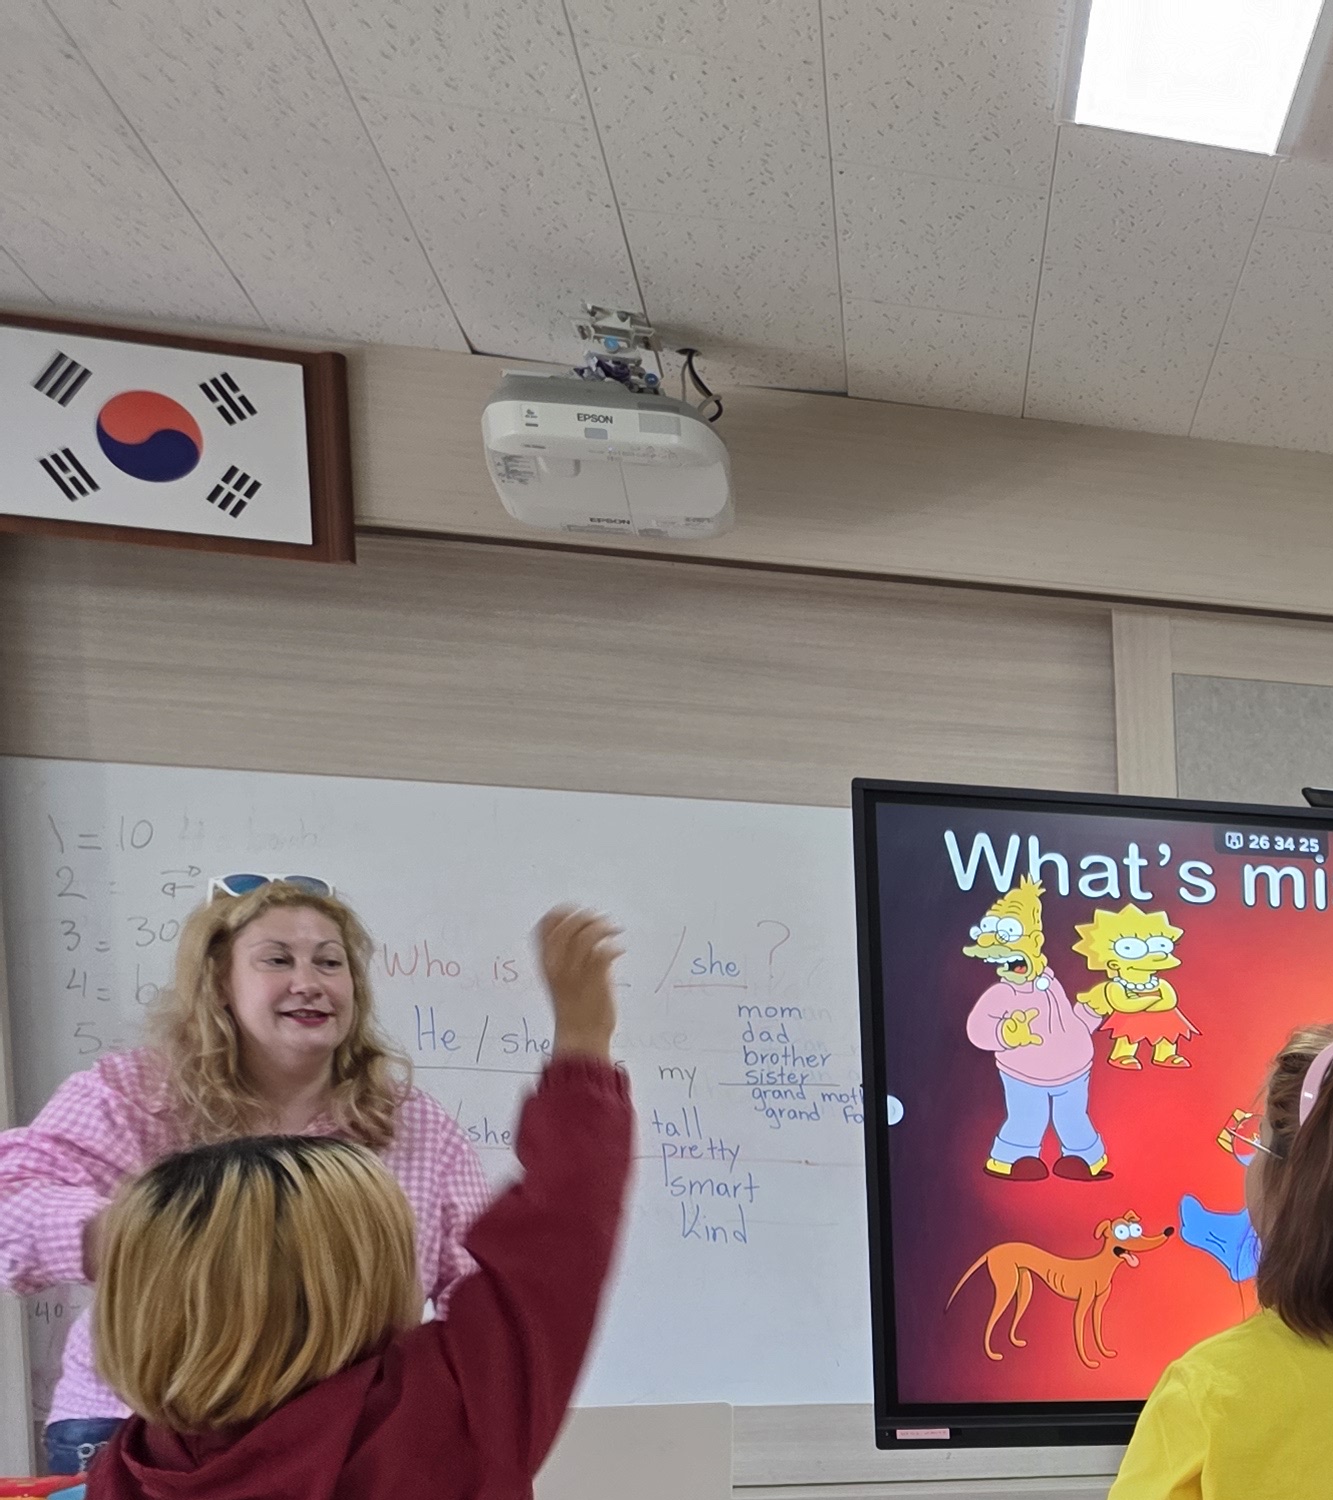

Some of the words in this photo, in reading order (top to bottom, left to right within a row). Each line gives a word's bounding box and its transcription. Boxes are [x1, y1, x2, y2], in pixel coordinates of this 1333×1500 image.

[577, 413, 613, 424] EPSON
[1249, 834, 1271, 849] 26
[1274, 836, 1295, 851] 34
[1299, 838, 1320, 853] 25
[944, 829, 1217, 904] What's
[56, 866, 87, 900] 2
[61, 920, 81, 951] 3
[384, 940, 461, 978] Who
[493, 956, 518, 983] is
[690, 941, 741, 977] she
[65, 968, 87, 998] 4
[737, 1003, 802, 1019] mom
[414, 1004, 461, 1051] He
[501, 1016, 553, 1056] she
[742, 1020, 790, 1044] dad
[743, 1044, 832, 1069] brother
[658, 1065, 697, 1099] my
[745, 1065, 810, 1086] sister
[751, 1082, 806, 1111] grand
[820, 1086, 863, 1105] mot
[652, 1105, 702, 1140] tall
[765, 1101, 821, 1129] grand
[467, 1117, 511, 1144] she
[661, 1137, 740, 1188] pretty
[670, 1172, 760, 1204] smart
